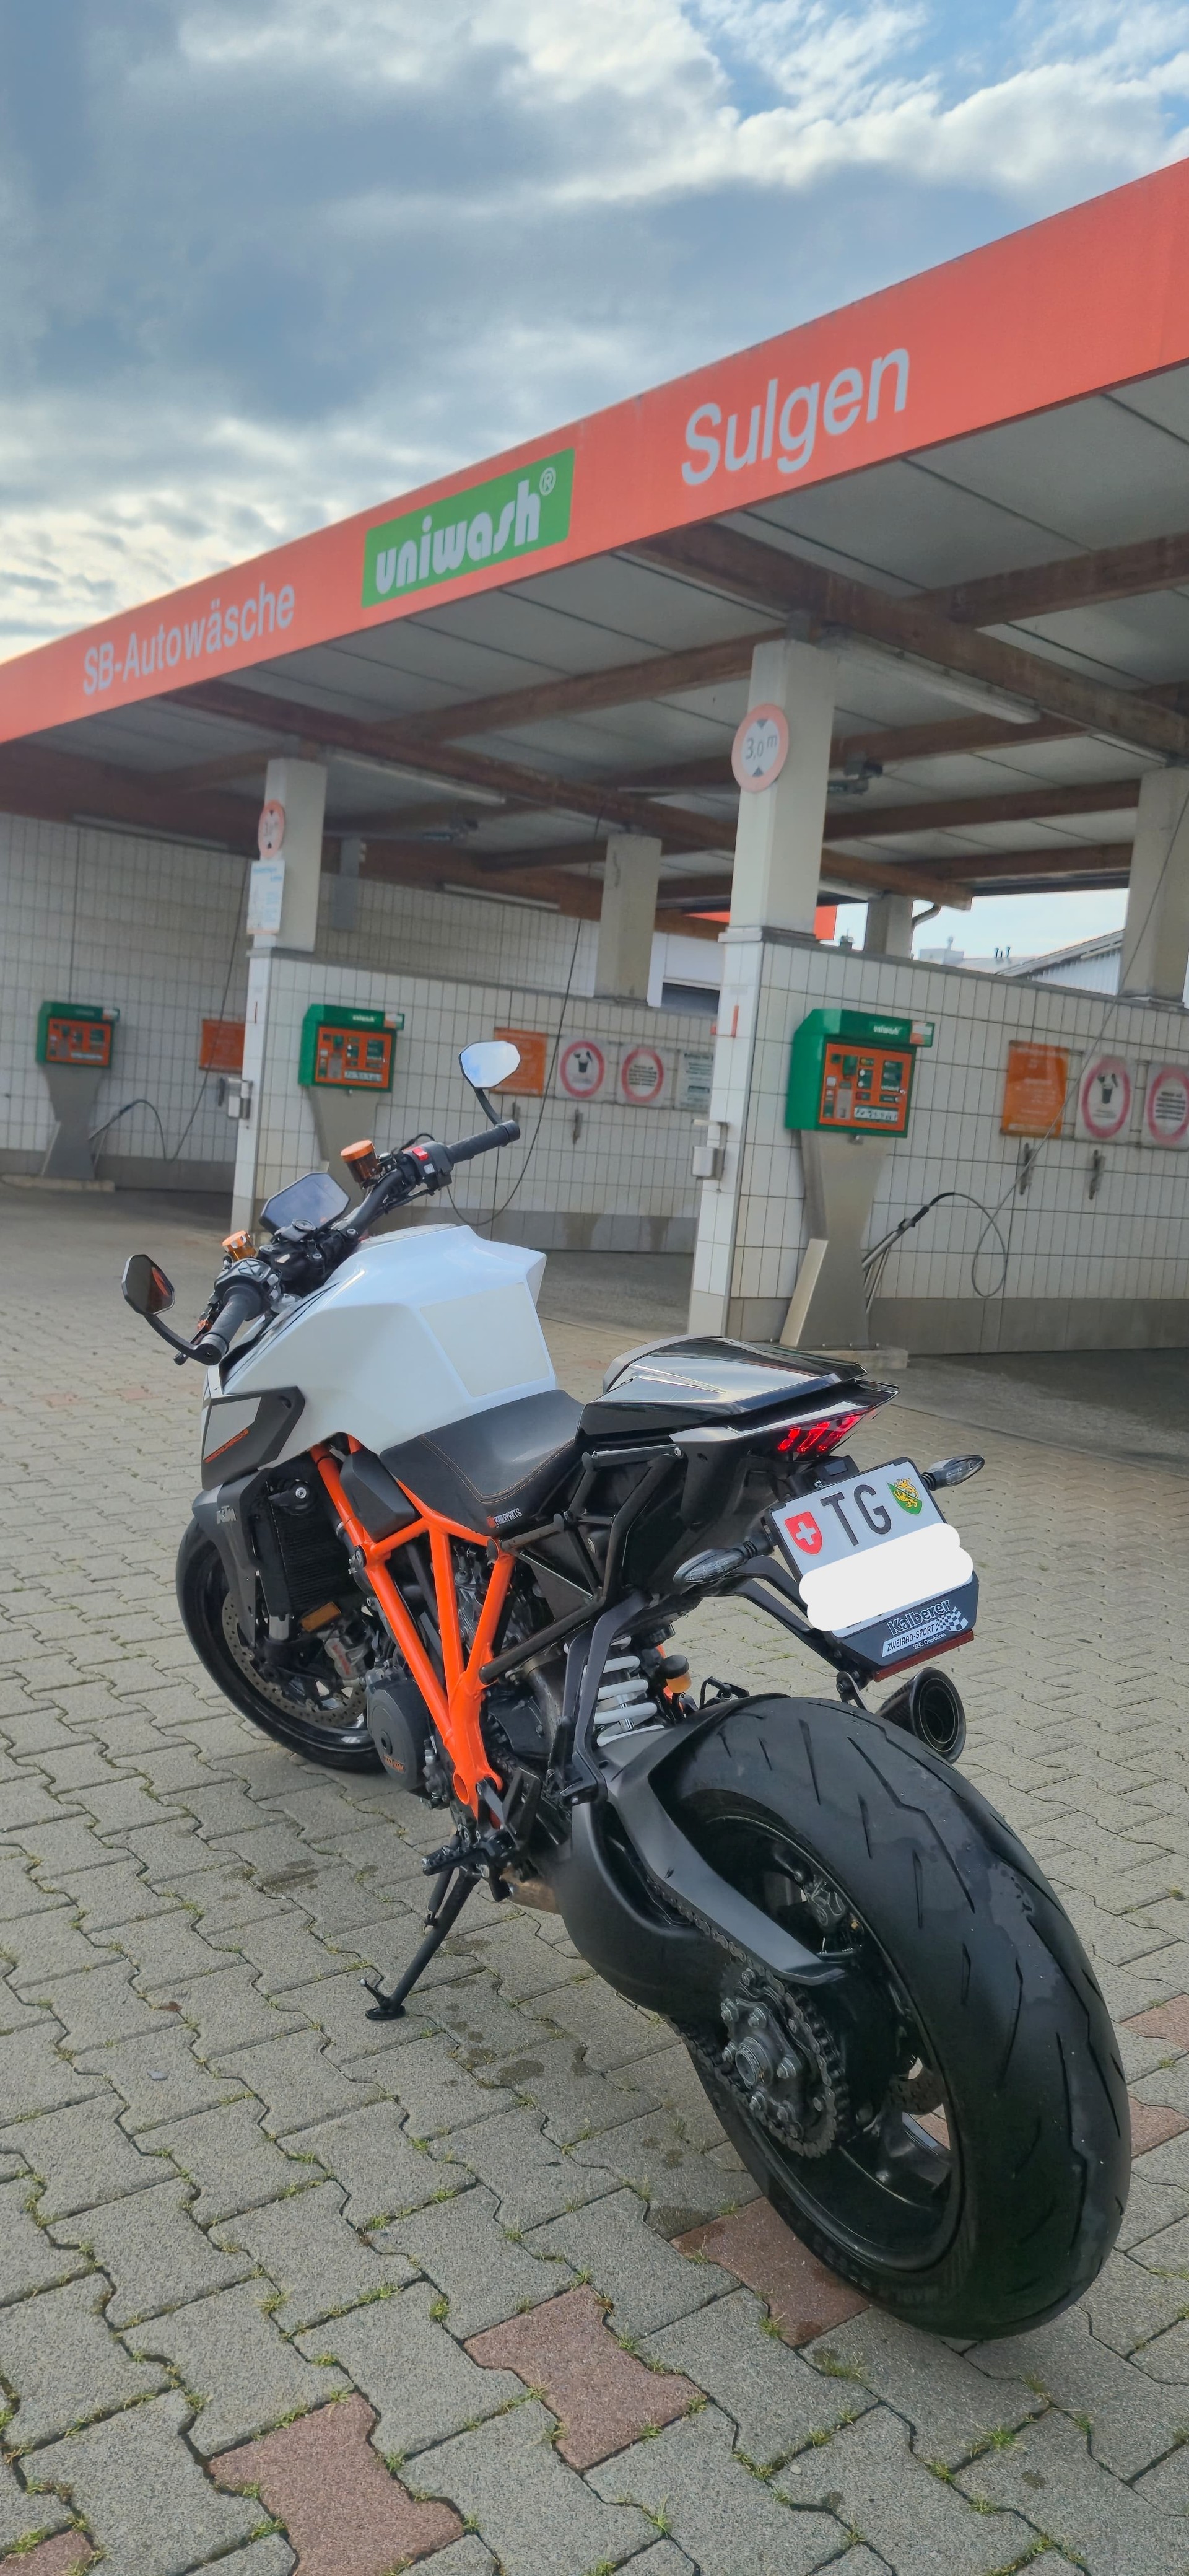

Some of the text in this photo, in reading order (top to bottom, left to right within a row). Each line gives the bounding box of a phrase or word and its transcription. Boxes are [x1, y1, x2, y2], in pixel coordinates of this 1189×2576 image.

[682, 348, 910, 486] Sulgen
[83, 582, 295, 696] SB-Autowäsche
[216, 1505, 237, 1524] KTM
[820, 1484, 891, 1546] TG
[887, 1600, 950, 1636] Kalberer
[887, 1623, 935, 1652] ZWEIRAD-SPORT
[913, 1632, 946, 1650] 9245 Oberbüren
